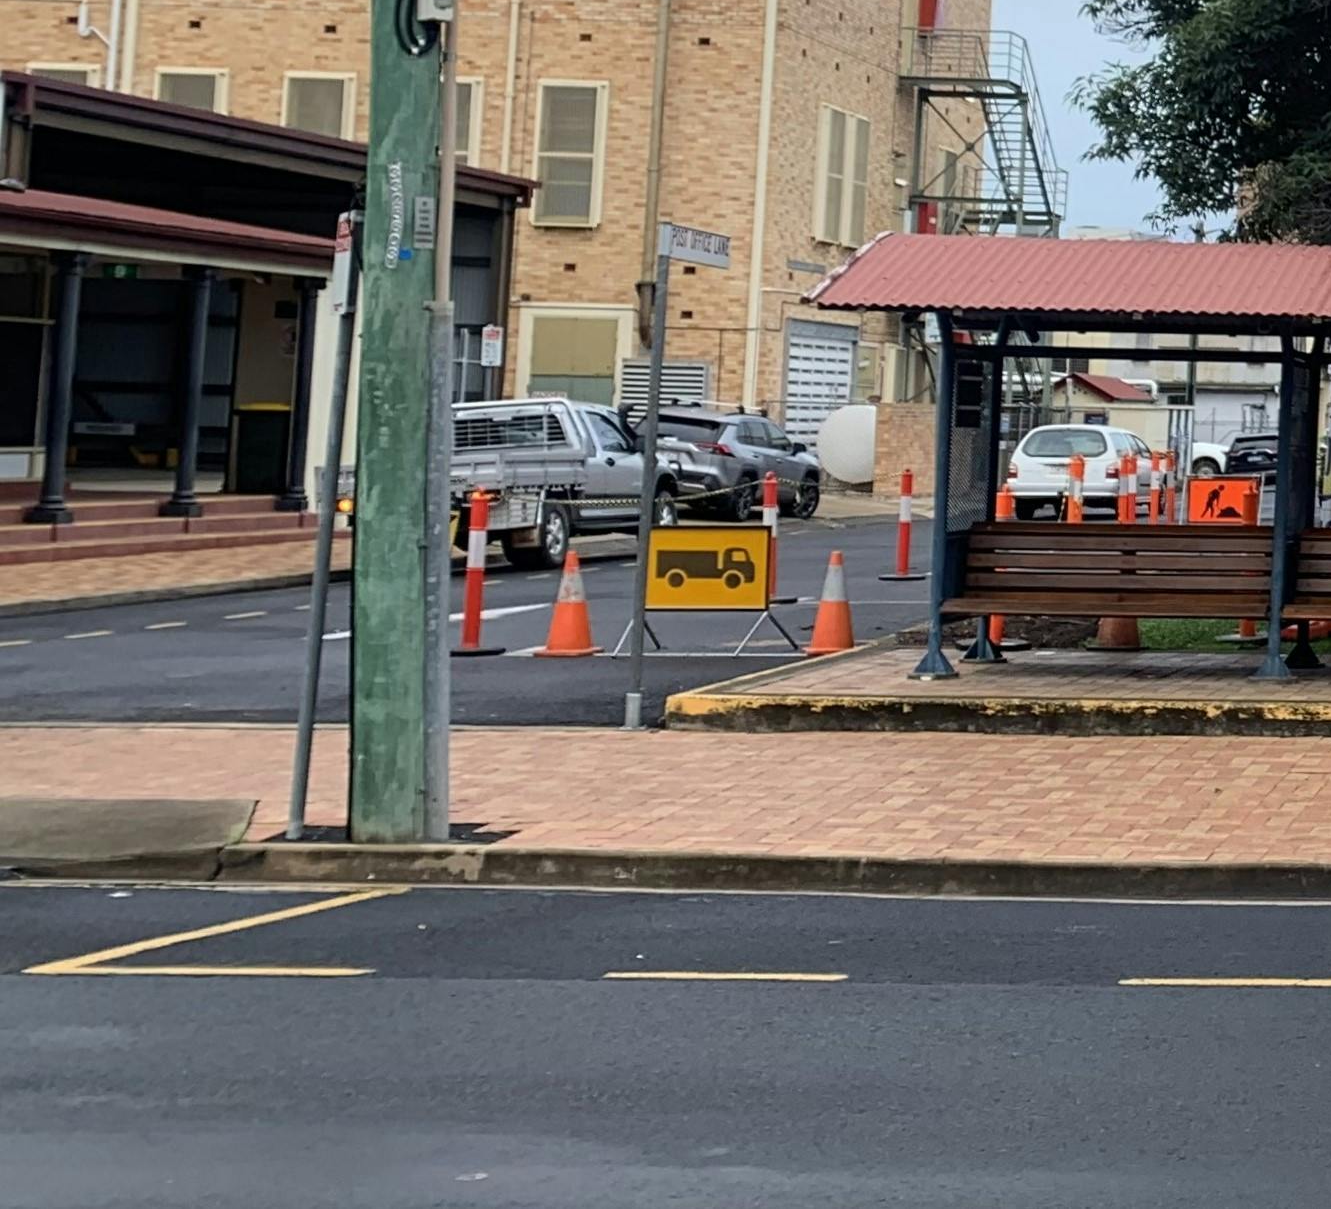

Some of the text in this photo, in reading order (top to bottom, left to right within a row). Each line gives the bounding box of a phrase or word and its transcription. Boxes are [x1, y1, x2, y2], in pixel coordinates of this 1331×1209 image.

[672, 227, 729, 257] POST OFFICE LANE
